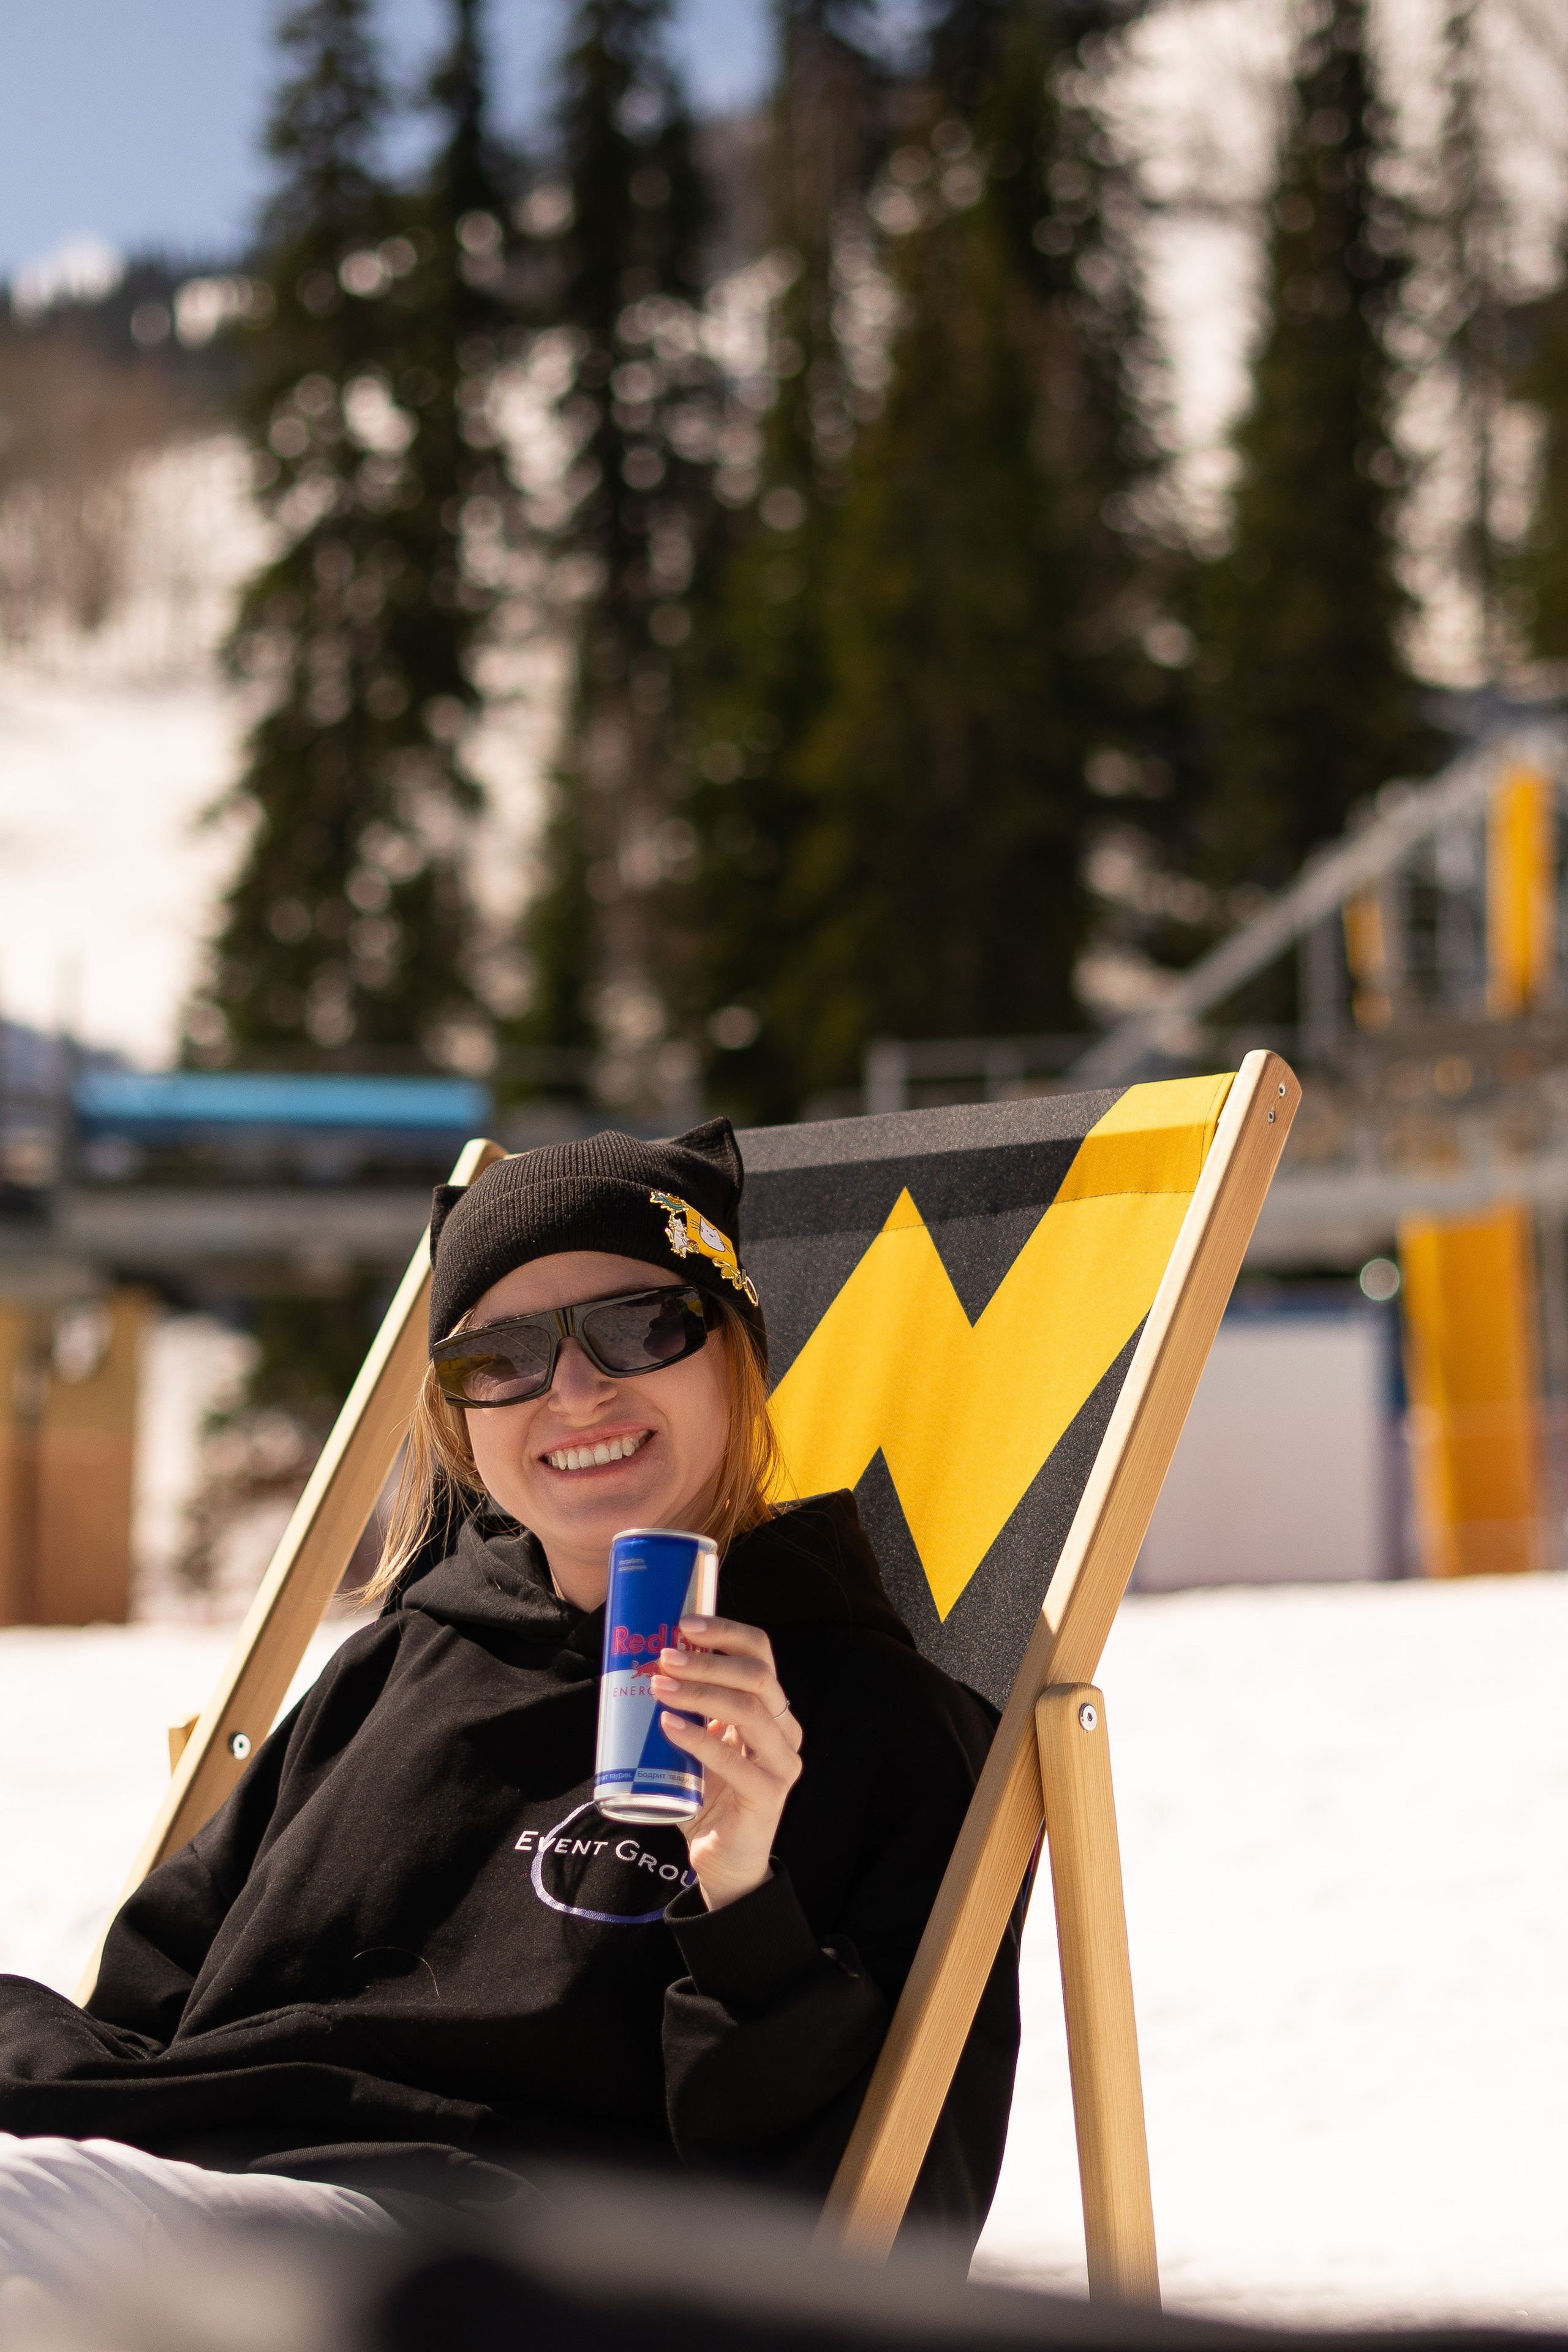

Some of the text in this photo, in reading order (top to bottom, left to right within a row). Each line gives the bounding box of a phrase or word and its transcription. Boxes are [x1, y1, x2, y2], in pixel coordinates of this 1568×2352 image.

[612, 1624, 668, 1654] Red
[612, 1686, 655, 1697] ENER
[638, 1770, 666, 1779] Бодрит
[514, 1830, 698, 1888] EVENT GROU
